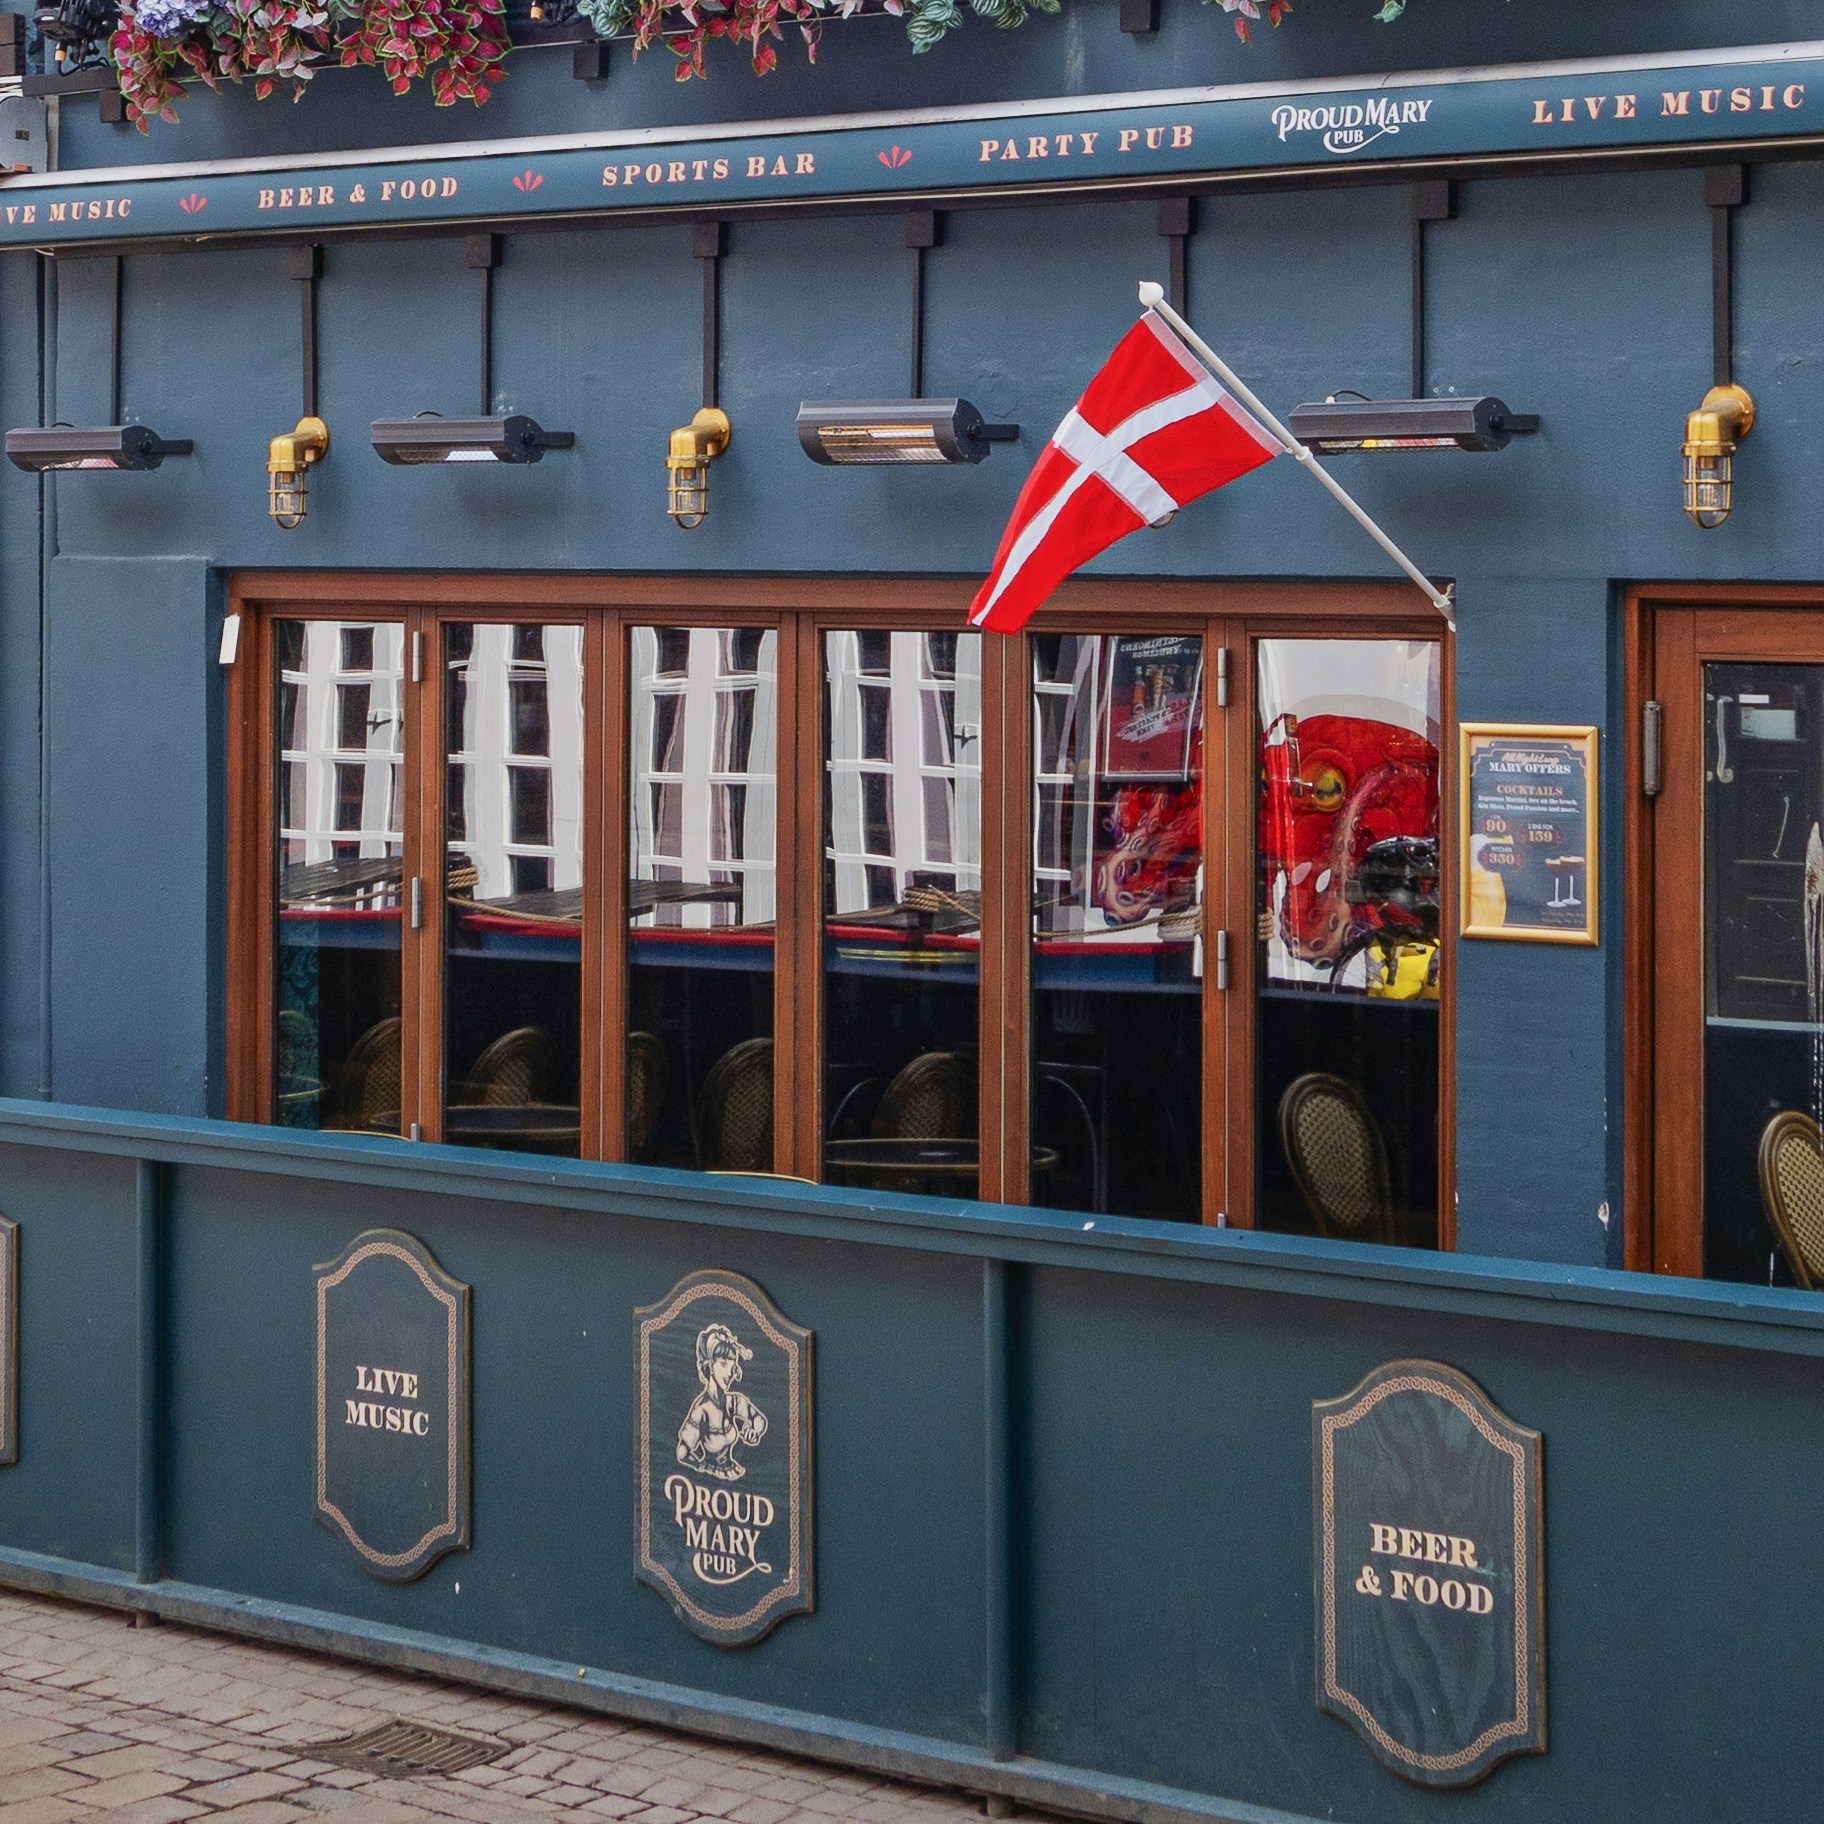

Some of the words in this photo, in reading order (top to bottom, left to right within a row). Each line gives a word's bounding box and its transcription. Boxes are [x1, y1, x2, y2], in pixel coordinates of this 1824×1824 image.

[1272, 104, 1363, 143] PROUD
[1364, 97, 1433, 134] MARY
[1532, 93, 1636, 125] LIVE
[1660, 84, 1806, 116] MUSIC
[978, 132, 1100, 163] PARTY
[1118, 124, 1195, 153] PUB
[603, 159, 729, 187] SPORTS
[746, 153, 816, 178] BAR
[49, 199, 132, 222] MUSIC
[258, 185, 335, 210] BEER
[349, 184, 366, 203] &
[381, 177, 459, 201] FOOD
[1489, 761, 1522, 773] MARY
[1525, 764, 1572, 774] OFFERS
[1496, 783, 1563, 796] COCKTAILS
[1486, 819, 1507, 832] 90
[1528, 830, 1553, 842] 159
[355, 1365, 419, 1399] LIVE
[345, 1399, 429, 1436] MUSIC
[664, 1474, 774, 1530] PROUD
[685, 1519, 761, 1565] MARY
[1369, 1522, 1478, 1568] BEER
[1355, 1565, 1382, 1596] &
[1390, 1569, 1495, 1614] FOOD
